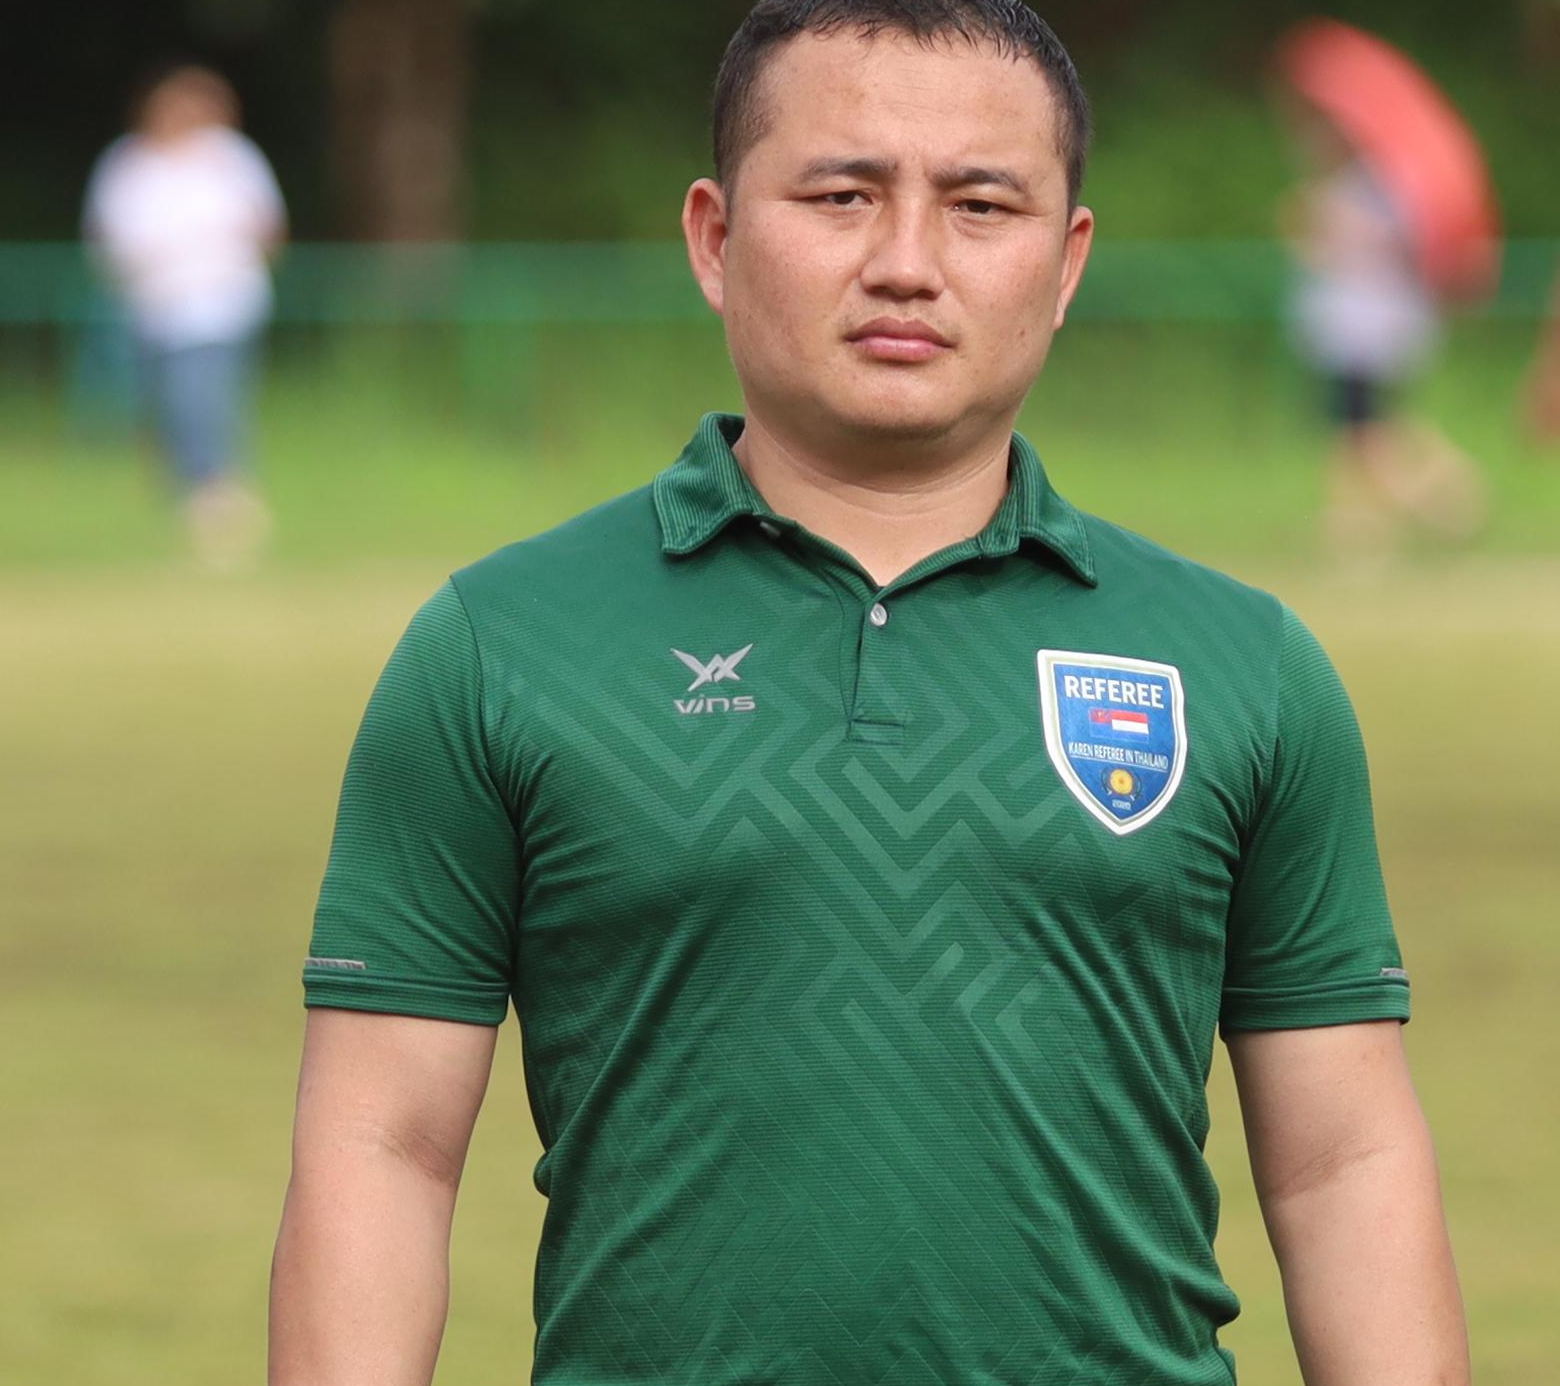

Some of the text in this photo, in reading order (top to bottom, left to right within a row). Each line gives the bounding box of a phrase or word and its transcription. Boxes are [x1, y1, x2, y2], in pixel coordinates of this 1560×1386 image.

[1064, 675, 1165, 709] REFEREE
[1068, 741, 1169, 769] KAREN REFEREE IN THAILAND
